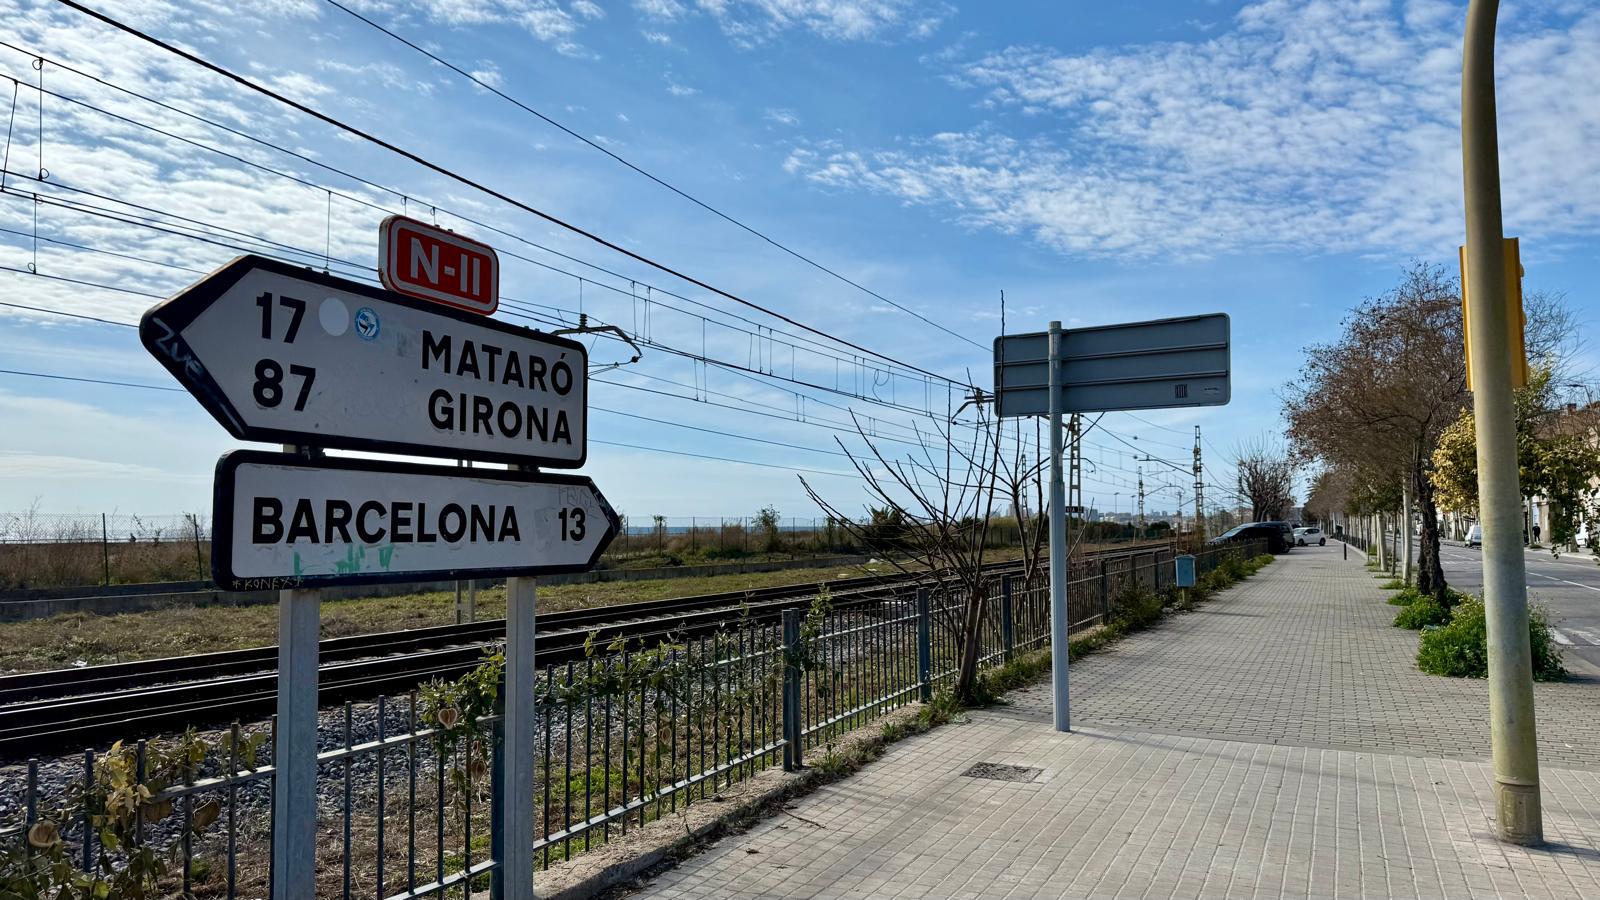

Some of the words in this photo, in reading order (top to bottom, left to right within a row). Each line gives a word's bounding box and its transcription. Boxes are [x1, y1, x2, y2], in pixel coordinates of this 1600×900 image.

[410, 236, 480, 296] N-II
[256, 291, 306, 344] 17
[421, 329, 573, 396] MATARÓ
[252, 358, 316, 412] 87
[428, 388, 572, 446] GIRONA
[252, 496, 521, 545] BARCELONA
[558, 507, 587, 543] 13
